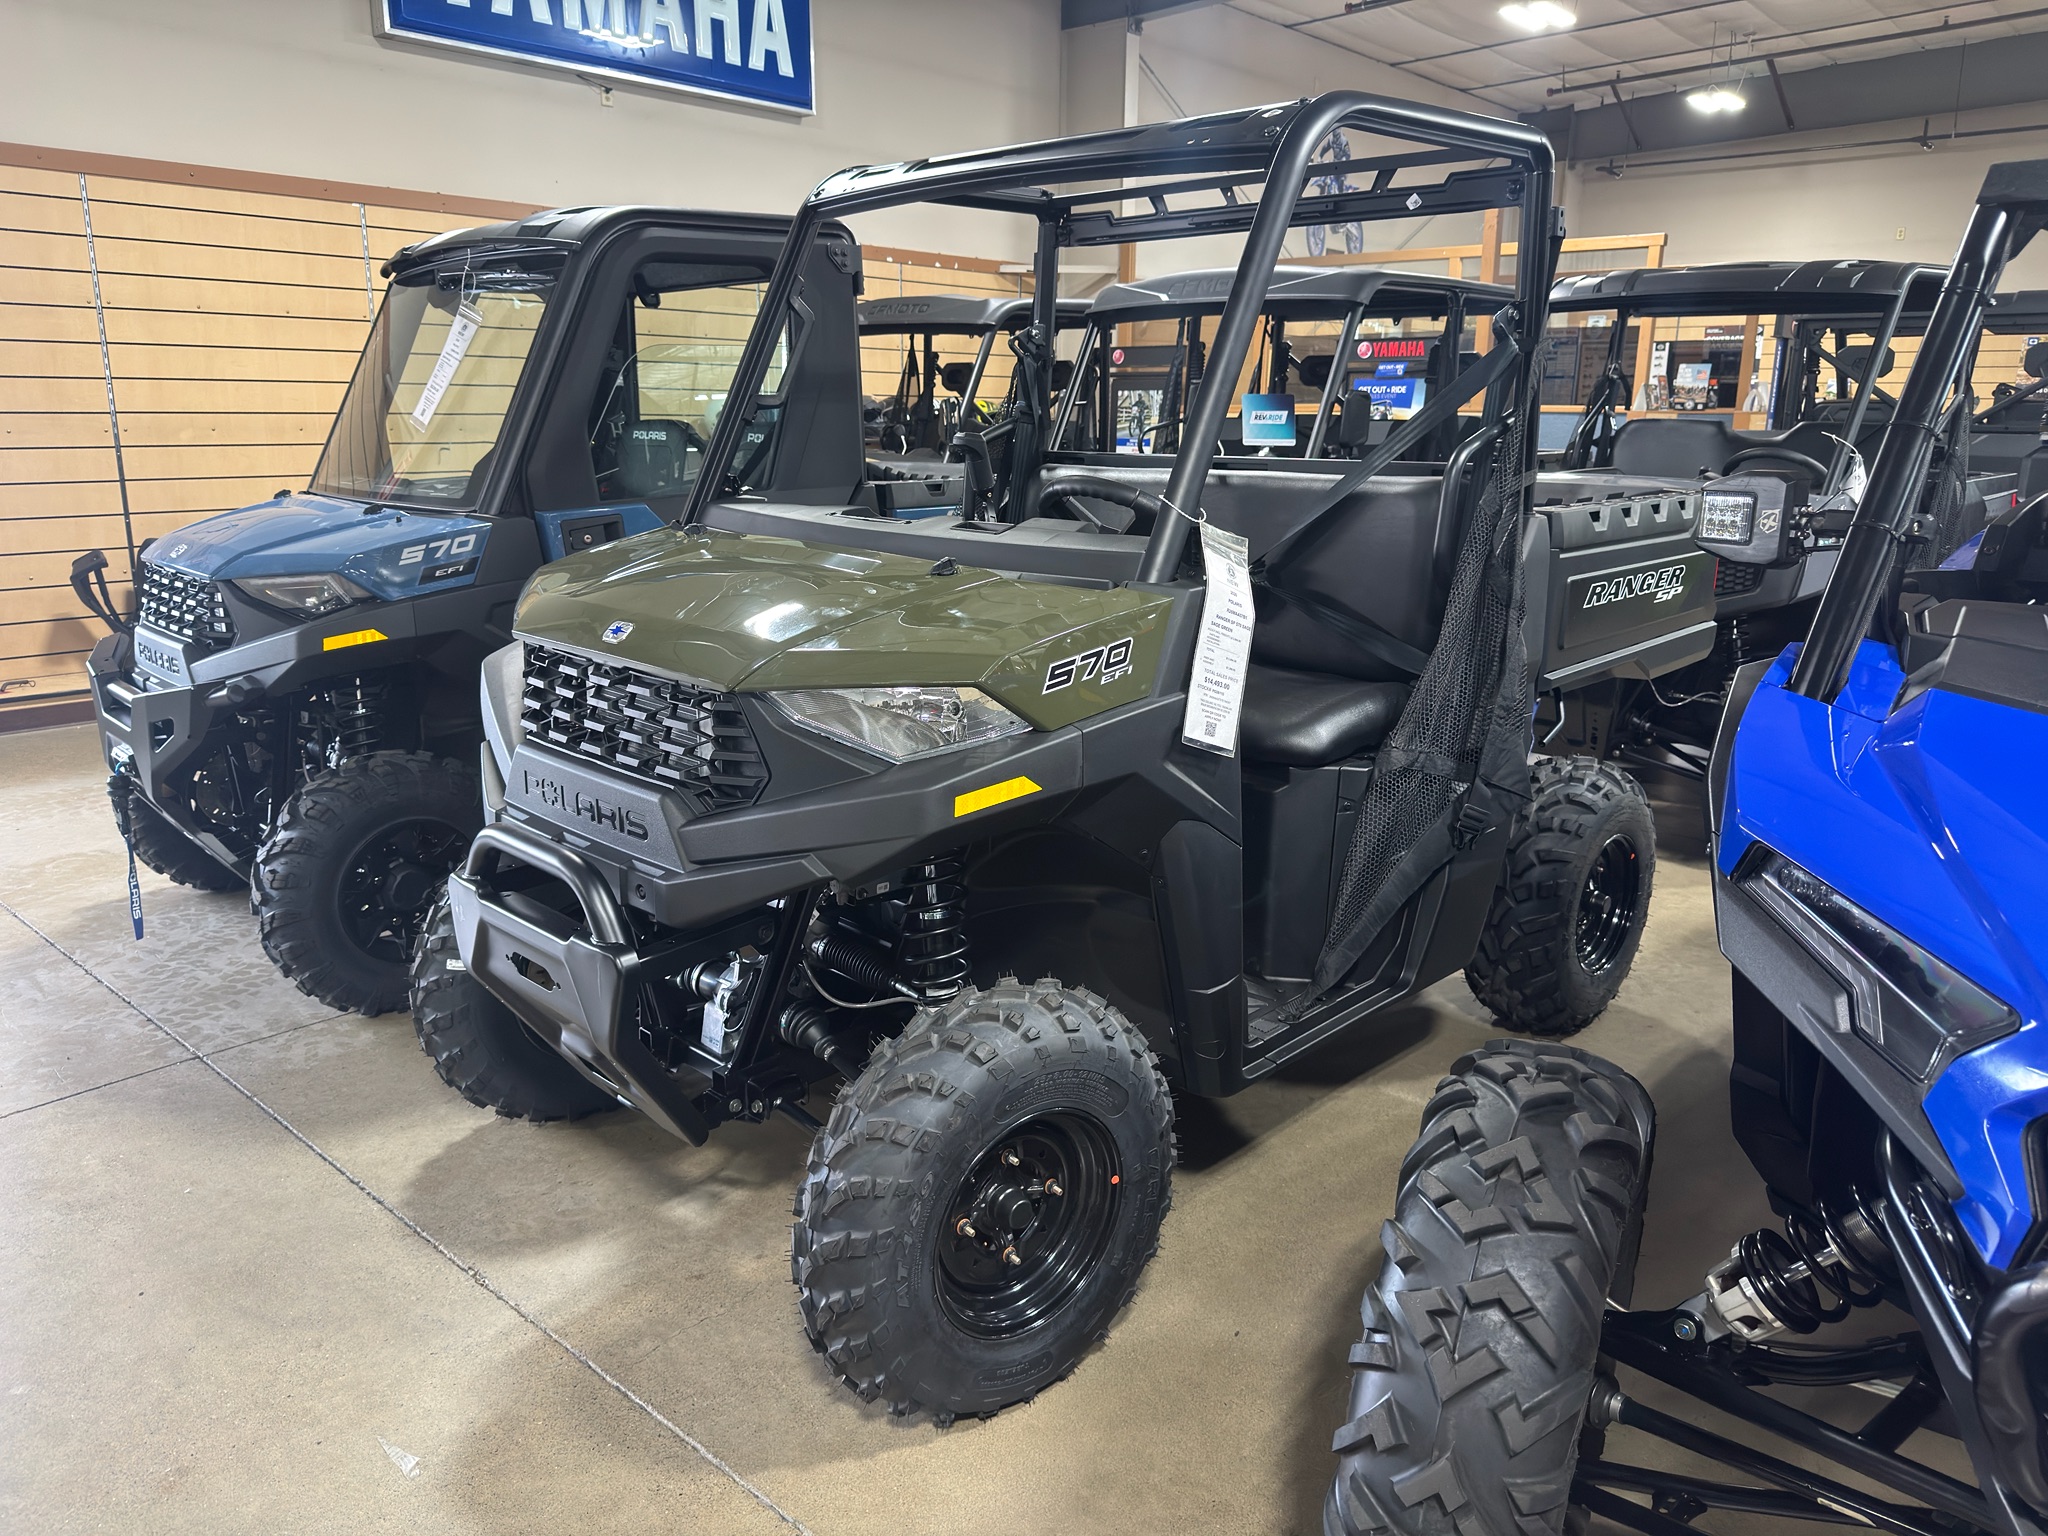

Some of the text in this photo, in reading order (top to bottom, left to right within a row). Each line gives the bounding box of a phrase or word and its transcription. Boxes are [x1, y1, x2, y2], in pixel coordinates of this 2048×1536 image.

[446, 0, 795, 78] AHA
[1167, 278, 1234, 296] CFMO
[866, 303, 930, 316] CFMOTO
[1372, 340, 1425, 358] YAMAHA
[1371, 385, 1387, 394] OUT
[1391, 386, 1407, 394] RIDE
[633, 430, 667, 440] POLARIS
[398, 533, 477, 566] 570
[435, 565, 464, 577] EFI
[1583, 564, 1686, 609] RANGER
[1653, 585, 1684, 604] SP
[138, 641, 181, 676] POLARIS
[1042, 636, 1134, 695] 570
[1100, 664, 1134, 685] EFI
[524, 770, 649, 842] POLARIS
[130, 863, 142, 920] POLARIS
